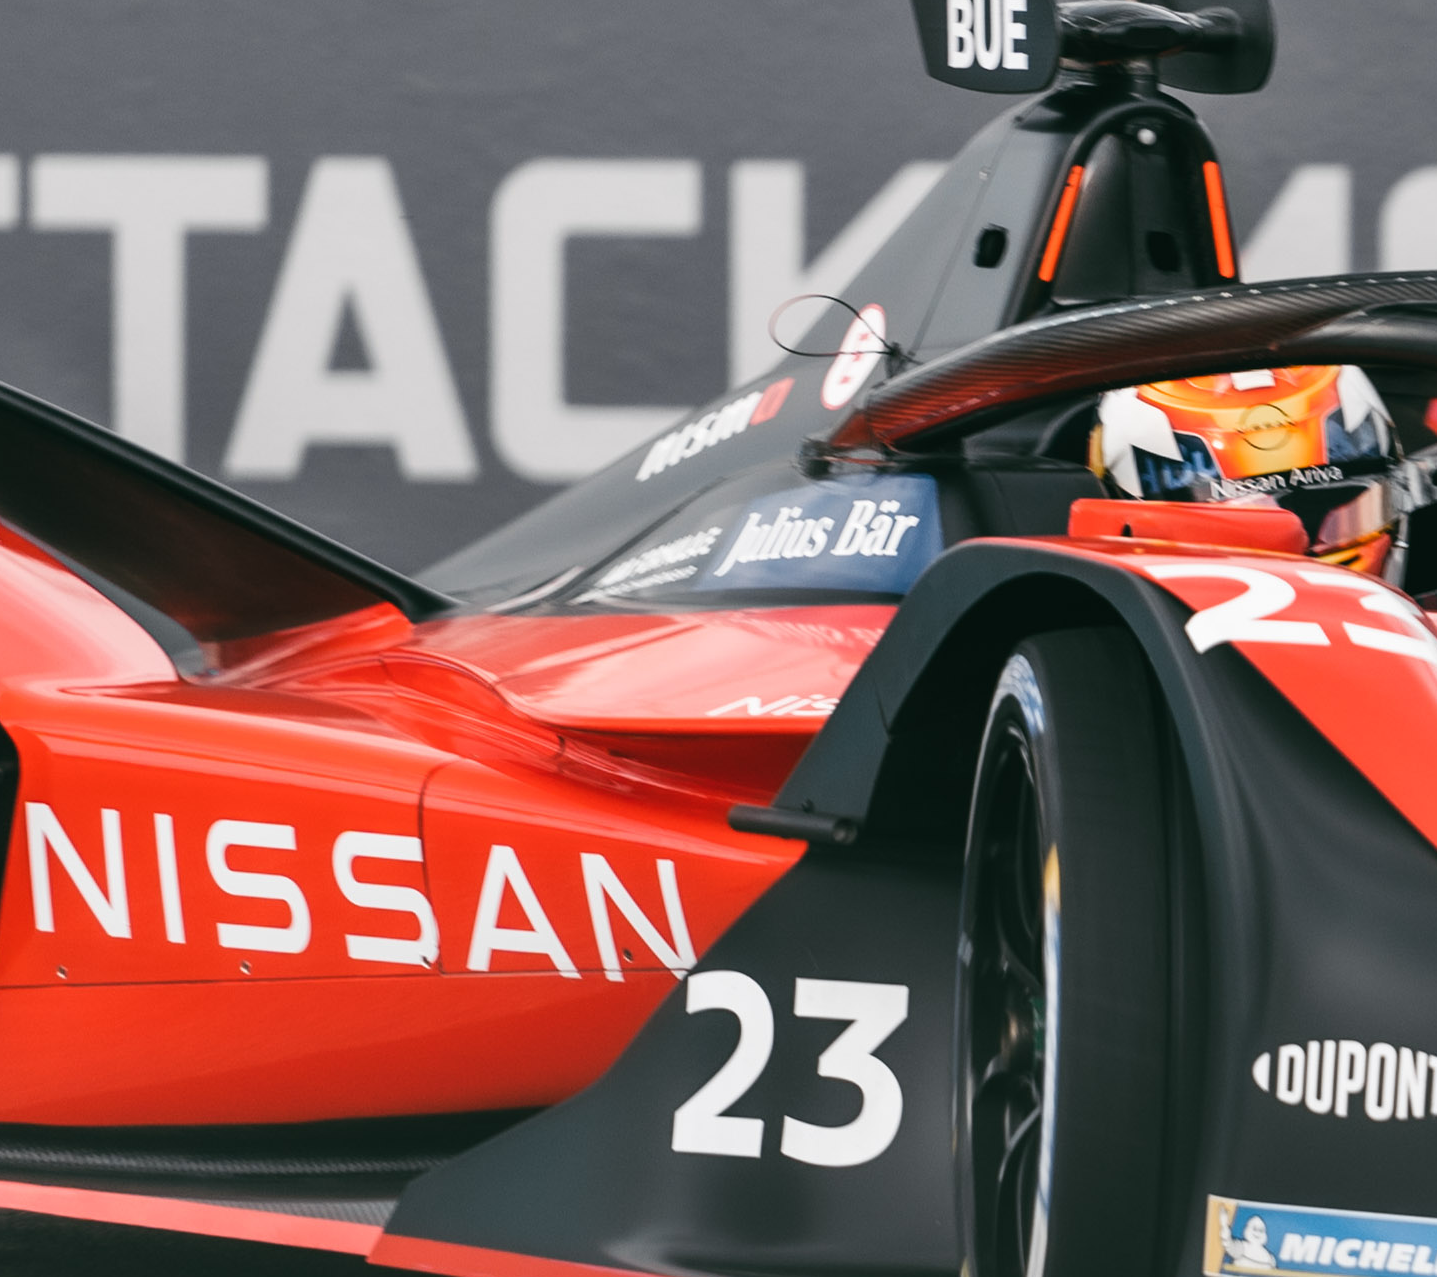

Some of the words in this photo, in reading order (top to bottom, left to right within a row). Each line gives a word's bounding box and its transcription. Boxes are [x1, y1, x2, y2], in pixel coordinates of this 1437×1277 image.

[713, 506, 836, 578] Julius
[829, 499, 921, 557] Bär
[24, 801, 699, 984] NISSAN
[671, 969, 910, 1168] 23
